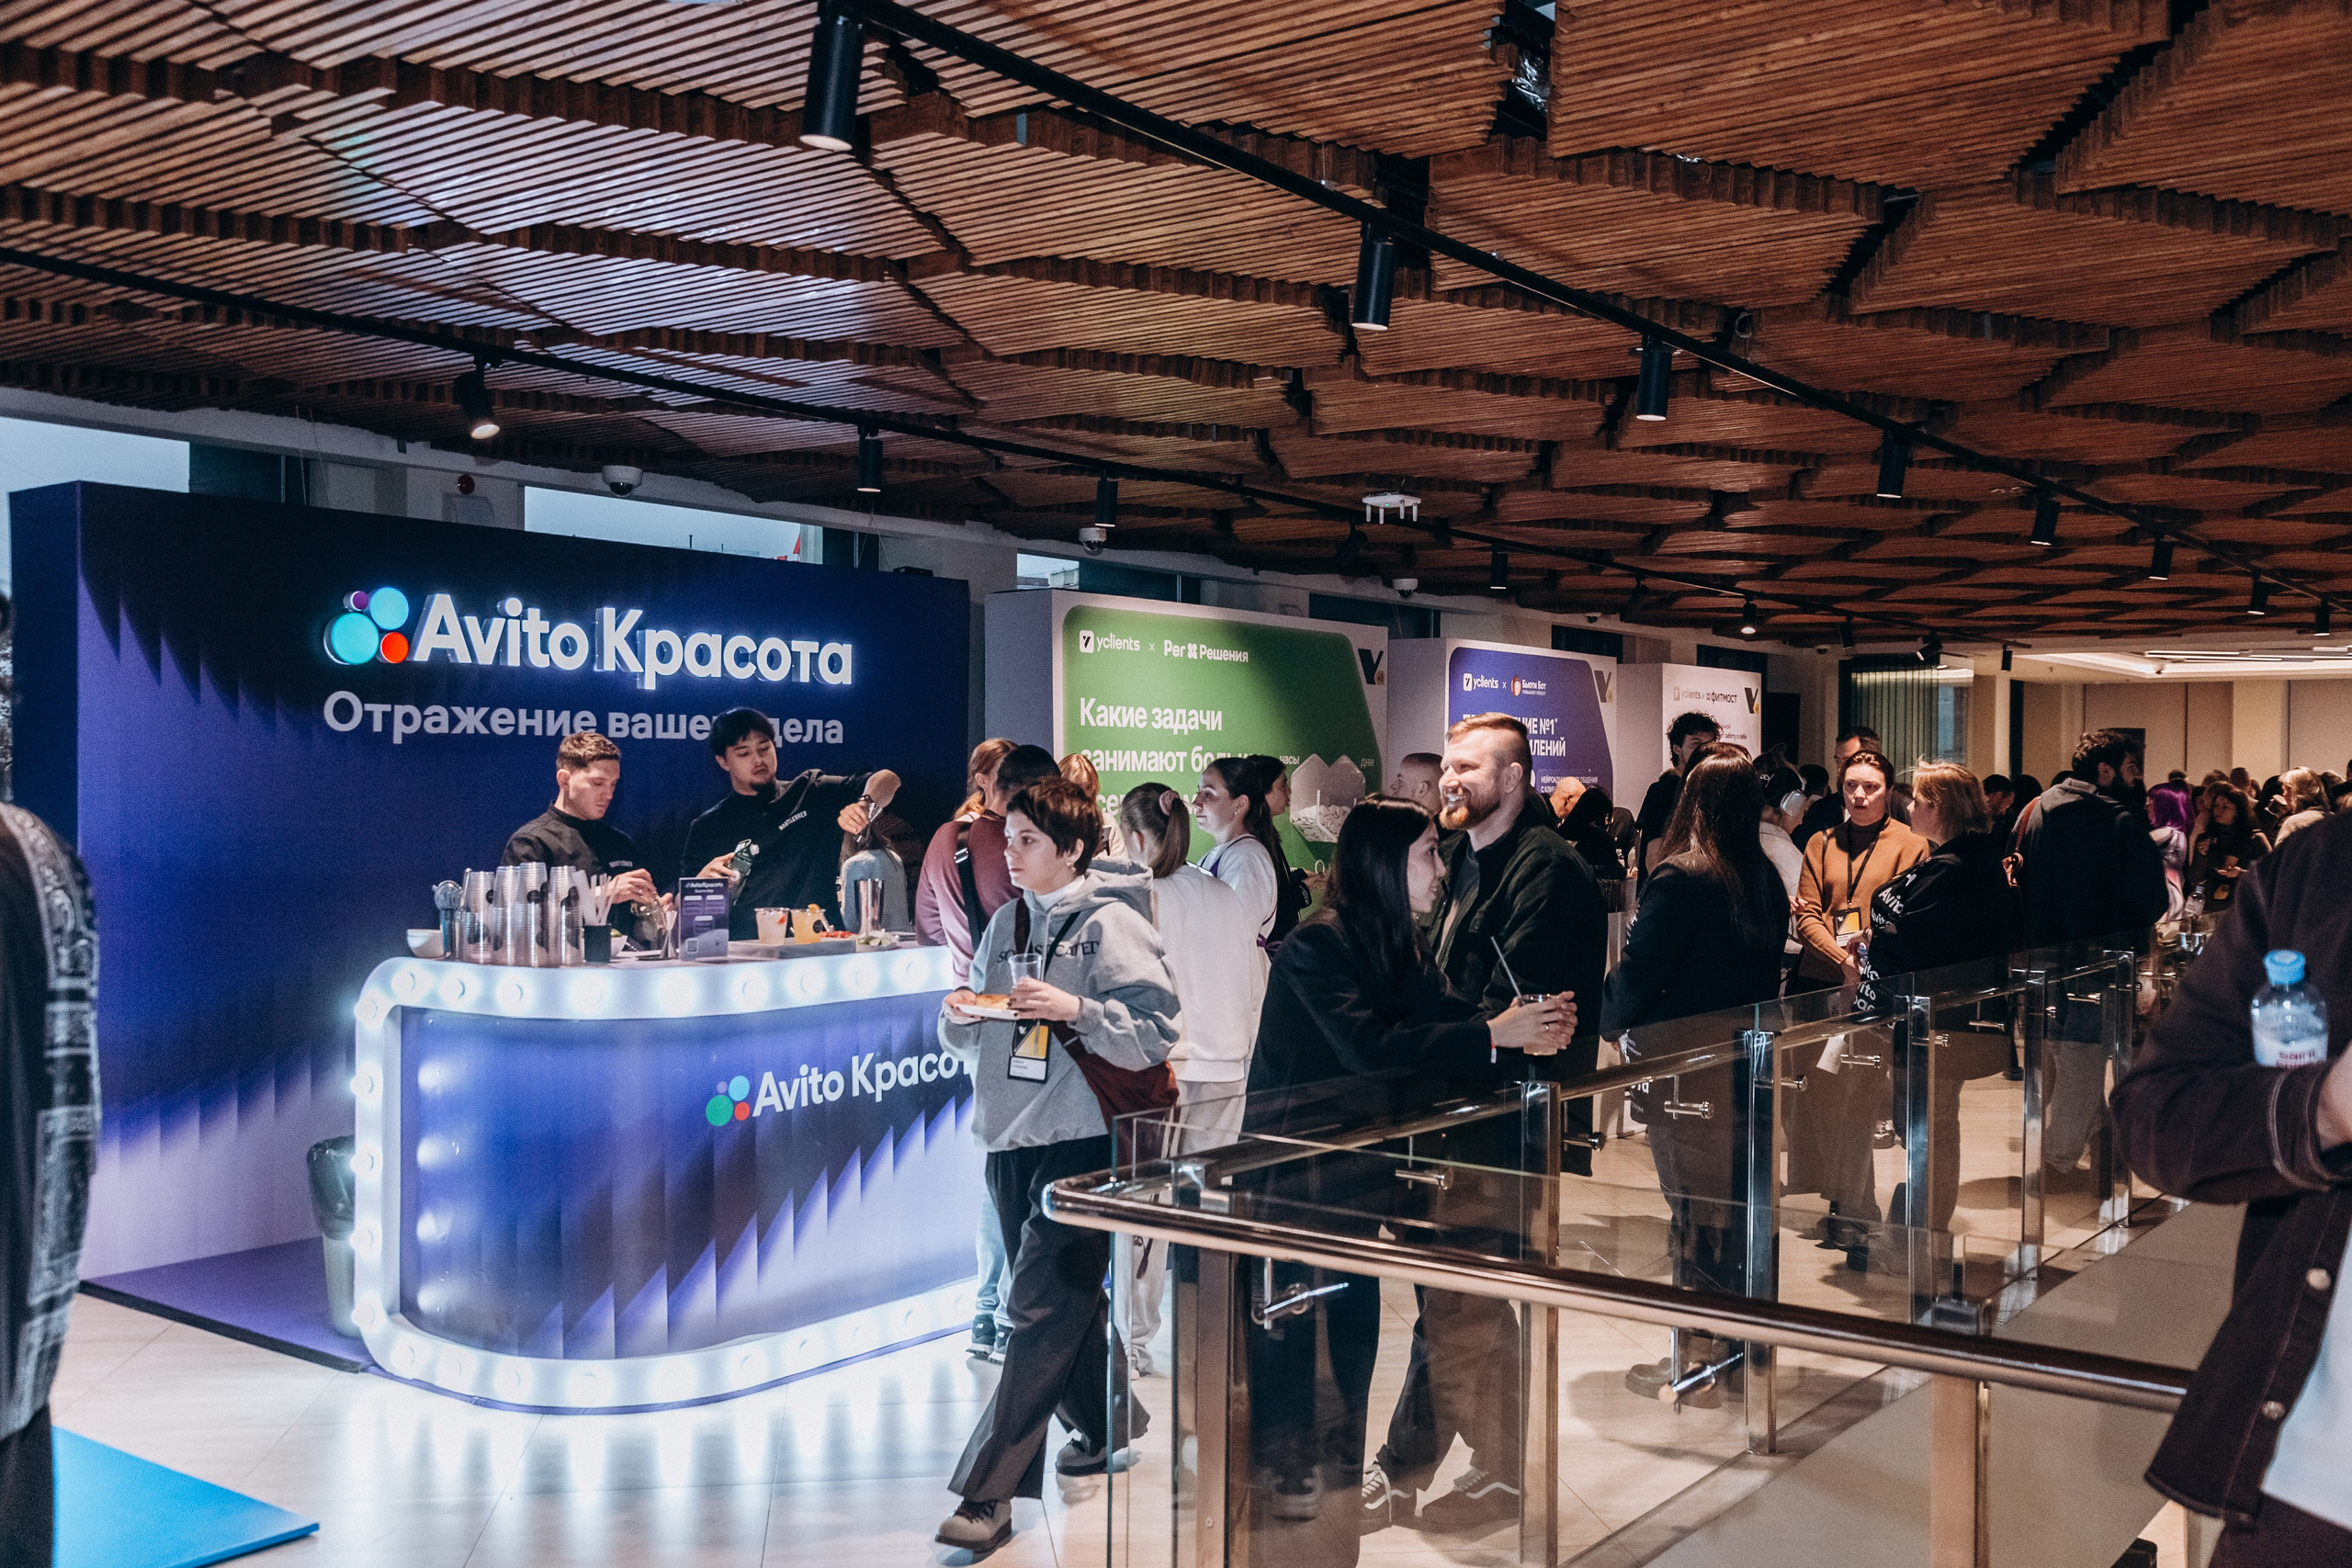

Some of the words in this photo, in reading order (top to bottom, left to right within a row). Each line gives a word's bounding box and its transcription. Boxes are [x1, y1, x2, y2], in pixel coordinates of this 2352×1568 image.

[413, 592, 590, 671] Avito
[594, 606, 853, 690] Красота
[1096, 632, 1140, 652] yclients
[1163, 639, 1186, 658] Рег
[1199, 644, 1249, 663] Решения
[1473, 674, 1498, 690] yclients
[322, 690, 599, 744] Отражение
[607, 712, 718, 740] ваше
[1080, 697, 1148, 728] Какие
[1150, 707, 1223, 736] задачи
[1857, 982, 1876, 1000] ito
[752, 1064, 844, 1117] Avito
[852, 1052, 971, 1102] Красо
